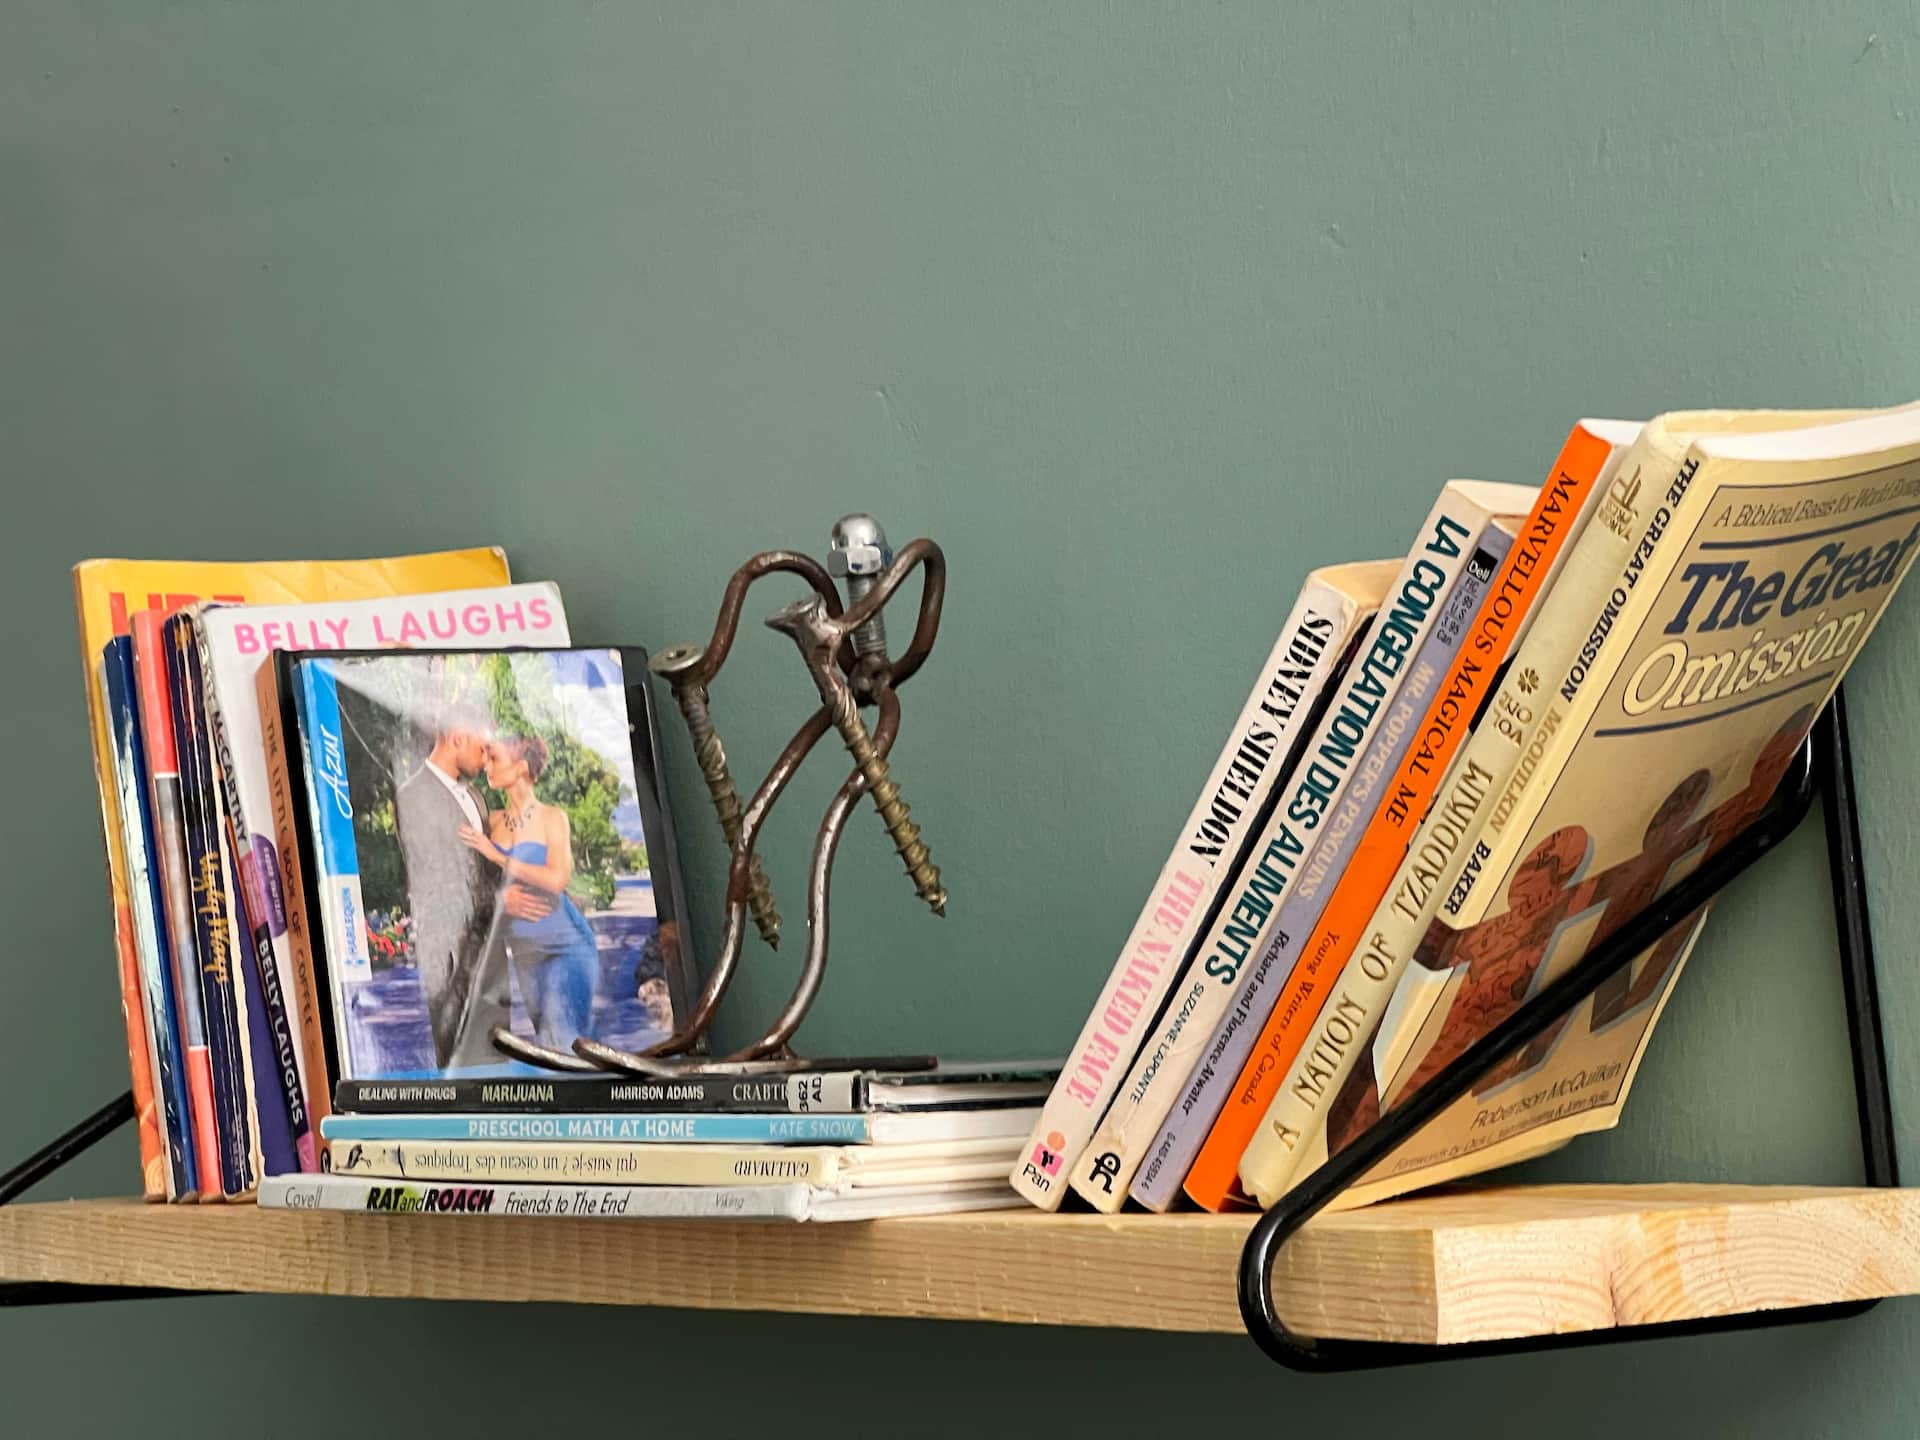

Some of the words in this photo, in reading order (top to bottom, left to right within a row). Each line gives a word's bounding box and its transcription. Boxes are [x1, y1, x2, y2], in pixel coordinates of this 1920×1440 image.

[1666, 457, 1700, 508] THE
[1425, 514, 1471, 559] LA
[1713, 505, 1733, 528] A
[1732, 499, 1801, 528] Biblical
[1468, 560, 1490, 581] Dell
[1475, 471, 1579, 655] MARVELLOUS
[1626, 505, 1671, 590] GREAT
[1663, 560, 1786, 636] The
[1780, 518, 1920, 618] Great
[234, 617, 350, 654] BELLY
[373, 598, 553, 645] LAUGHS
[1560, 587, 1628, 703] OMISSION
[1260, 609, 1334, 731] SIDNEY
[1319, 559, 1446, 770] CONGELATION
[1622, 608, 1867, 716] Omission
[1408, 657, 1484, 776] MAGICAL
[214, 711, 248, 843] McCARTHY
[318, 724, 354, 819] Azur
[1352, 702, 1414, 802] POPPER'S
[1189, 722, 1279, 868] SHELDON
[1288, 761, 1341, 830] DES
[1386, 783, 1417, 828] ME
[1298, 801, 1361, 900] PENGUINS
[1154, 869, 1205, 938] THE
[1204, 823, 1305, 985] ALIMENTS
[1443, 839, 1492, 916] BAKER
[291, 911, 302, 938] OF
[1254, 930, 1291, 986] Richard
[1273, 1119, 1300, 1151] A
[1291, 991, 1368, 1112] NATION
[1360, 931, 1397, 983] OF
[1390, 759, 1494, 925] TZADDIKIM
[1305, 930, 1341, 977] Young
[1103, 931, 1173, 1036] NAKED
[1240, 980, 1260, 1010] and
[1281, 980, 1314, 1033] Writers
[257, 938, 280, 1011] BELLY
[274, 1015, 303, 1125] LAUGHS
[1166, 981, 1205, 1042] SUZANNE
[1207, 1008, 1247, 1066] Florence
[1065, 1031, 1121, 1109] FACE
[1273, 1032, 1284, 1058] of
[358, 1086, 397, 1101] DEALING
[400, 1086, 422, 1101] WITH
[424, 1086, 457, 1101] DRUGS
[482, 1085, 554, 1102] MARIJUANA
[610, 1085, 665, 1101] HARRISON
[666, 1085, 705, 1101] ADAMS
[732, 1083, 788, 1102] CRABT
[797, 1080, 809, 1112] 362
[1130, 1040, 1174, 1105] LAPOINTE
[1182, 1061, 1216, 1116] Atwater
[1240, 1053, 1276, 1106] Canada
[468, 1119, 563, 1137] PRESCHOOL
[568, 1119, 614, 1137] MATH
[618, 1119, 641, 1137] AT
[645, 1119, 696, 1137] HOME
[769, 1120, 806, 1137] KATE
[809, 1120, 857, 1137] SNOW
[414, 1149, 472, 1175] Tropiques
[475, 1154, 498, 1172] des
[499, 1154, 538, 1171] oiseau
[538, 1155, 560, 1171] un
[571, 1153, 612, 1176] suis-je
[617, 1152, 638, 1177] qui
[734, 1160, 810, 1178] GALLIMARD
[1022, 1162, 1051, 1193] Pan
[285, 1187, 323, 1209] Covell
[504, 1189, 552, 1214] Friends
[555, 1192, 568, 1214] to
[572, 1190, 596, 1214] The
[600, 1189, 632, 1214] End
[714, 1192, 745, 1210] Viking
